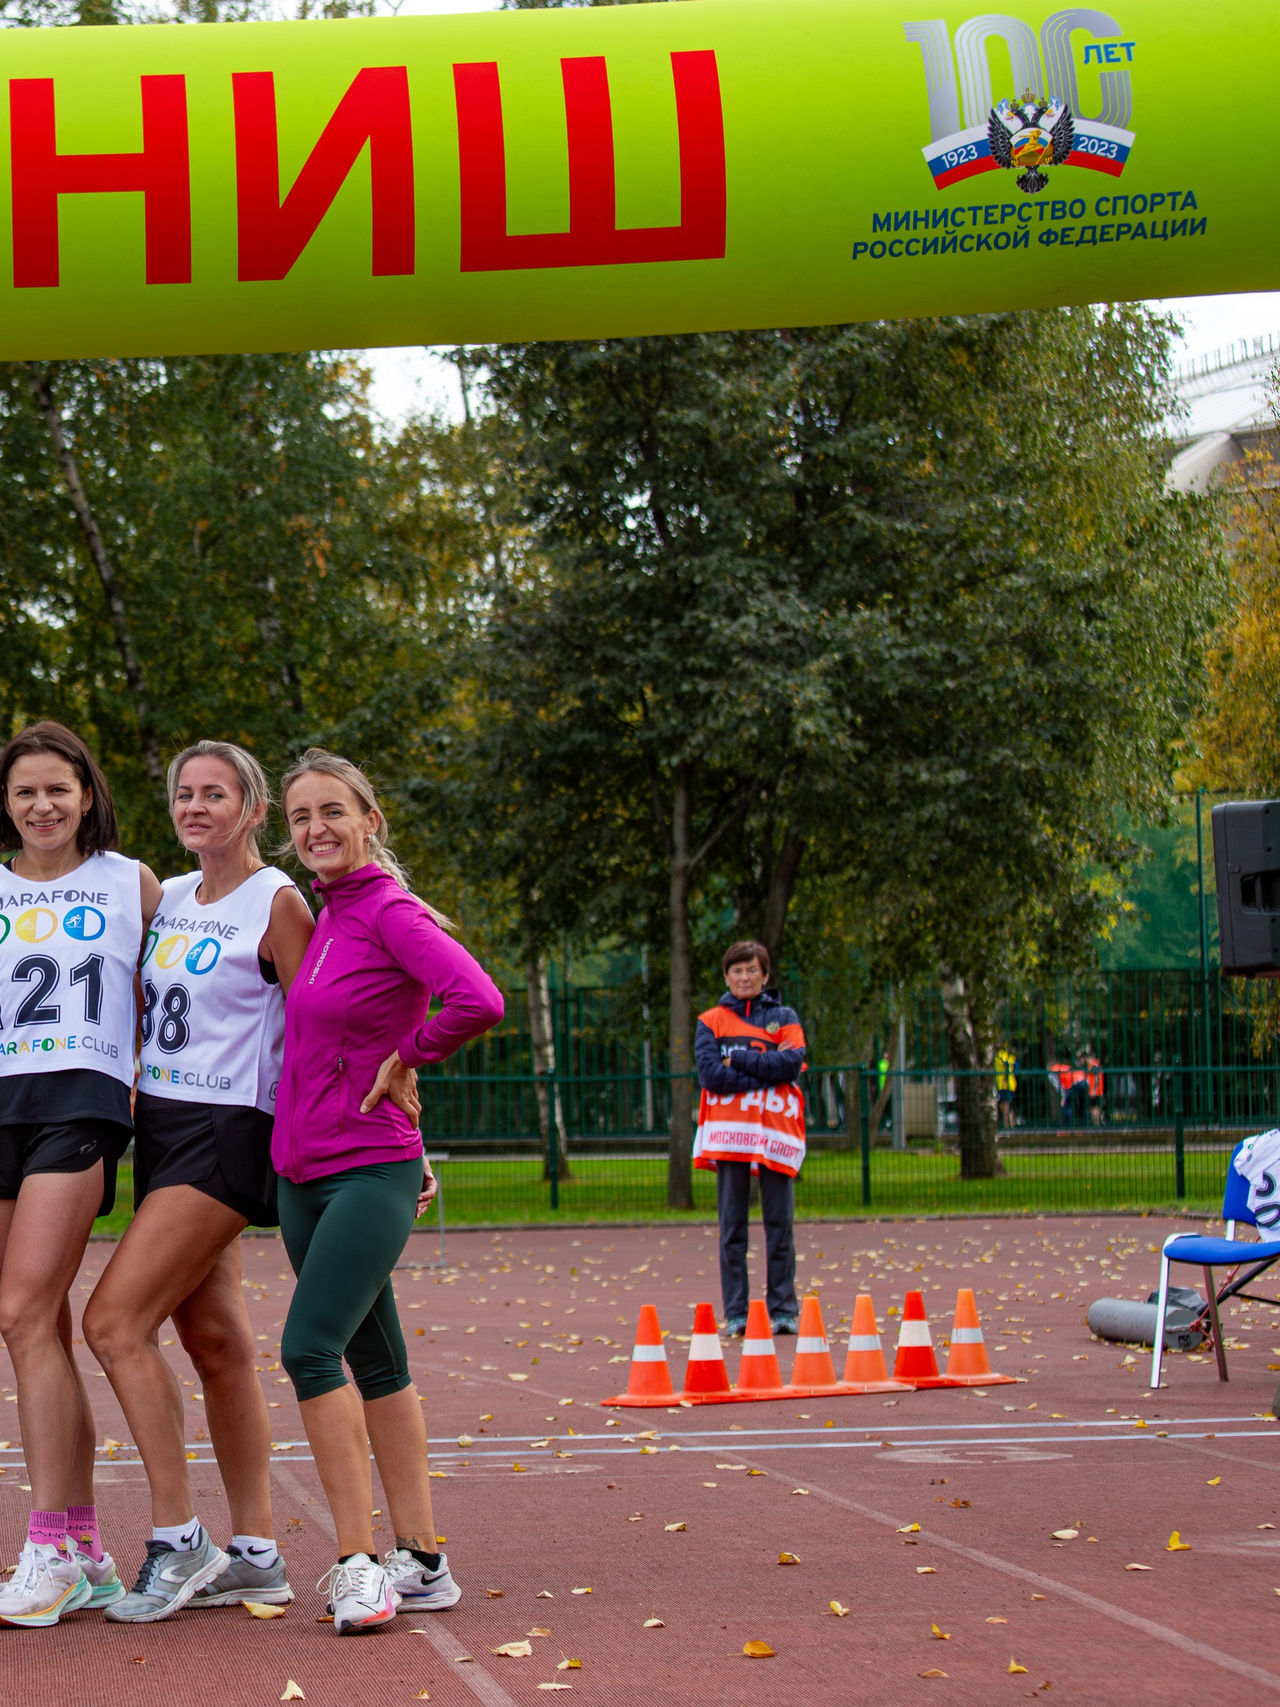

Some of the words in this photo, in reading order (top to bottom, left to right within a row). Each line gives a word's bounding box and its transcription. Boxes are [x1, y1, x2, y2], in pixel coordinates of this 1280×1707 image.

[1083, 42, 1136, 65] ЛЕТ
[941, 144, 978, 169] 1923
[1078, 136, 1118, 160] 2023
[872, 198, 1086, 233] МИНИСТЕРСТВО
[1094, 190, 1198, 217] СПОРТА
[852, 225, 1030, 260] РОССИЙСКОЙ
[1038, 217, 1207, 248] ФЕДЕРАЦИИ
[308, 938, 334, 985] NORDSKI
[140, 1062, 231, 1090] AFONE.CLUB
[709, 1131, 769, 1151] МОСКОВСЙ
[769, 1140, 800, 1160] СПОРТ
